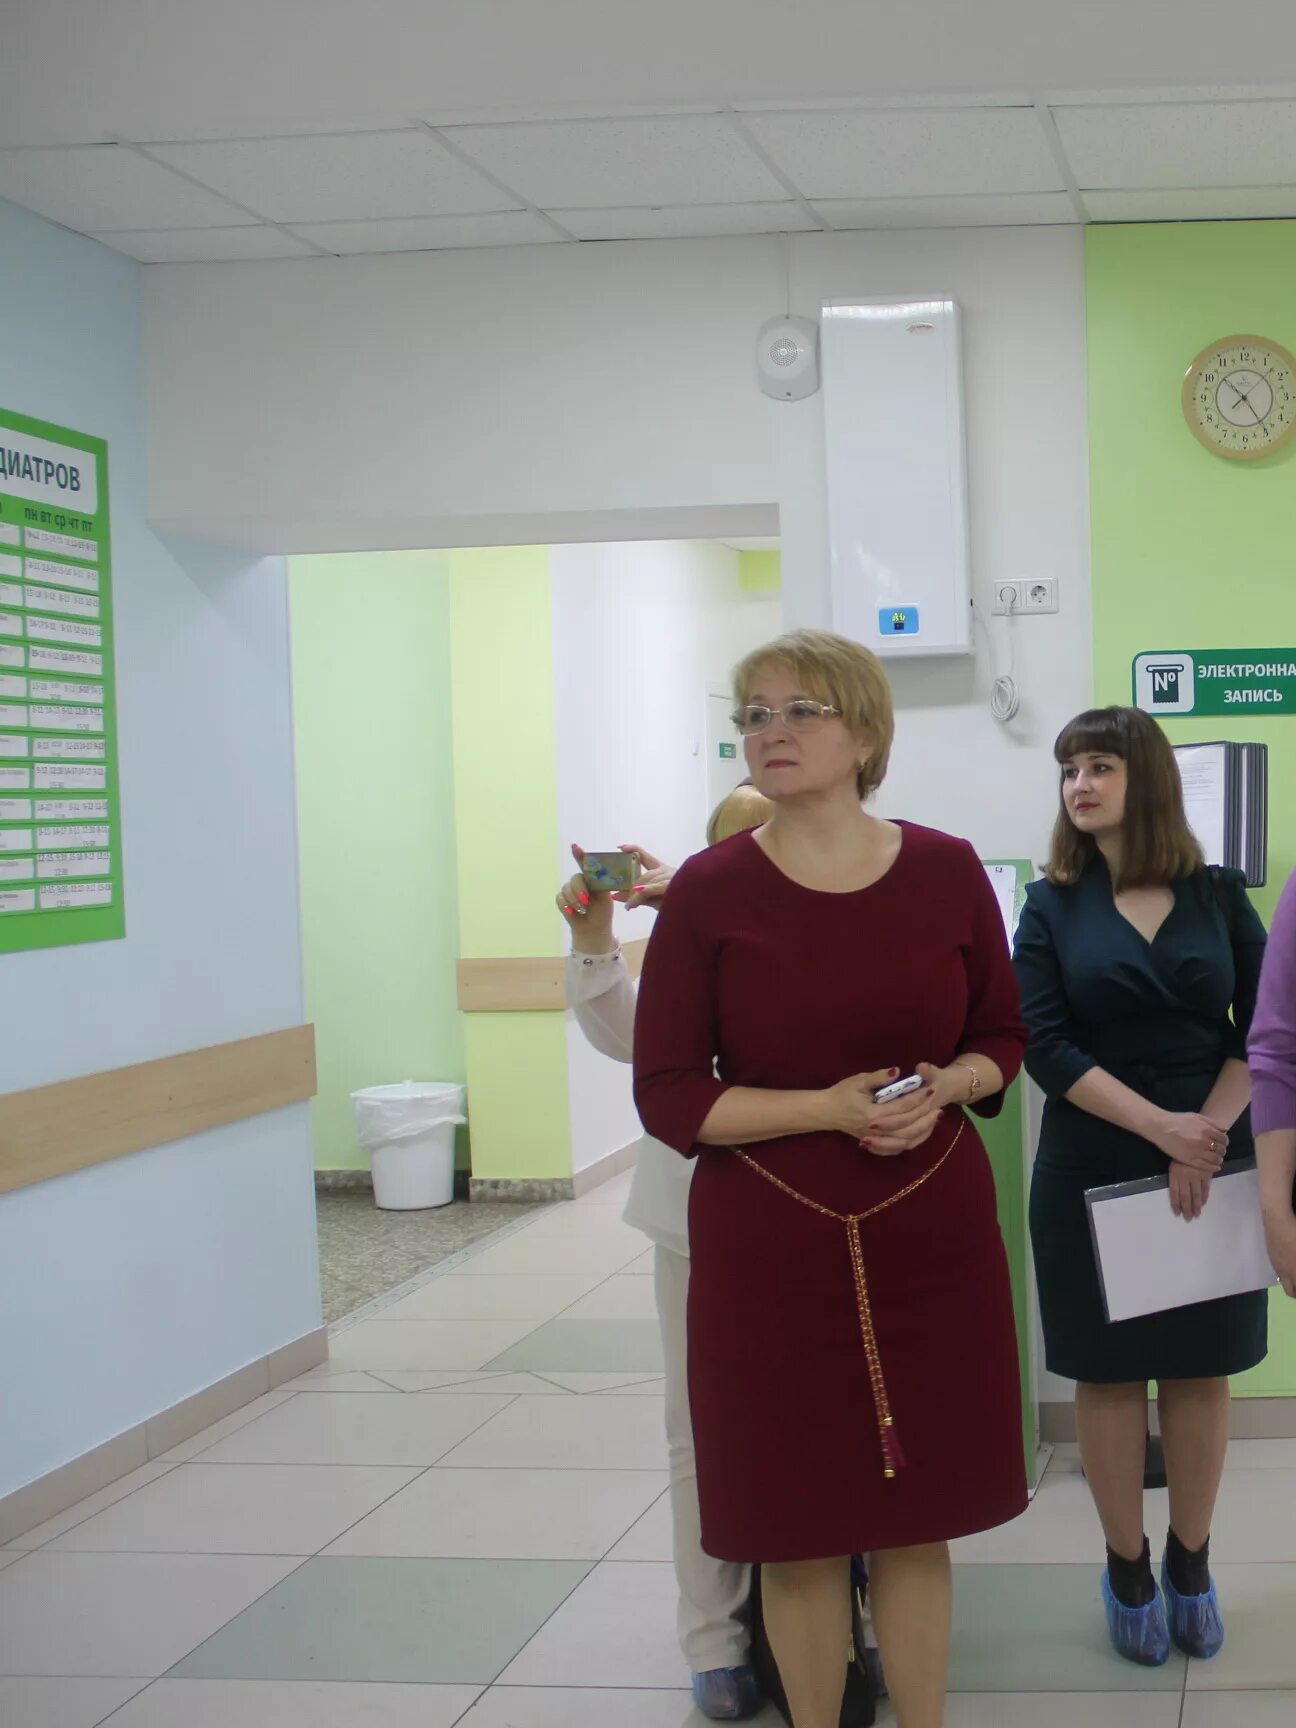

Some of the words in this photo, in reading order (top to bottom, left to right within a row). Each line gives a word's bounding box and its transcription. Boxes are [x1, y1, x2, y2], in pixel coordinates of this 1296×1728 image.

[1240, 352, 1250, 361] 12
[1219, 358, 1227, 367] 11
[1263, 357, 1267, 366] 1
[1205, 373, 1215, 382] 10
[1277, 372, 1284, 381] 2
[1200, 394, 1207, 403] 9
[1283, 392, 1289, 401] 3
[1278, 413, 1283, 422] 4
[1222, 429, 1228, 438] 7
[1263, 427, 1269, 438] 5
[1242, 434, 1248, 443] 6
[24, 507, 38, 521] пн
[41, 511, 52, 524] вт
[54, 514, 66, 530] ср
[68, 518, 80, 529] чт
[82, 520, 93, 532] пт
[1224, 689, 1283, 703] ЗАПИСЬ
